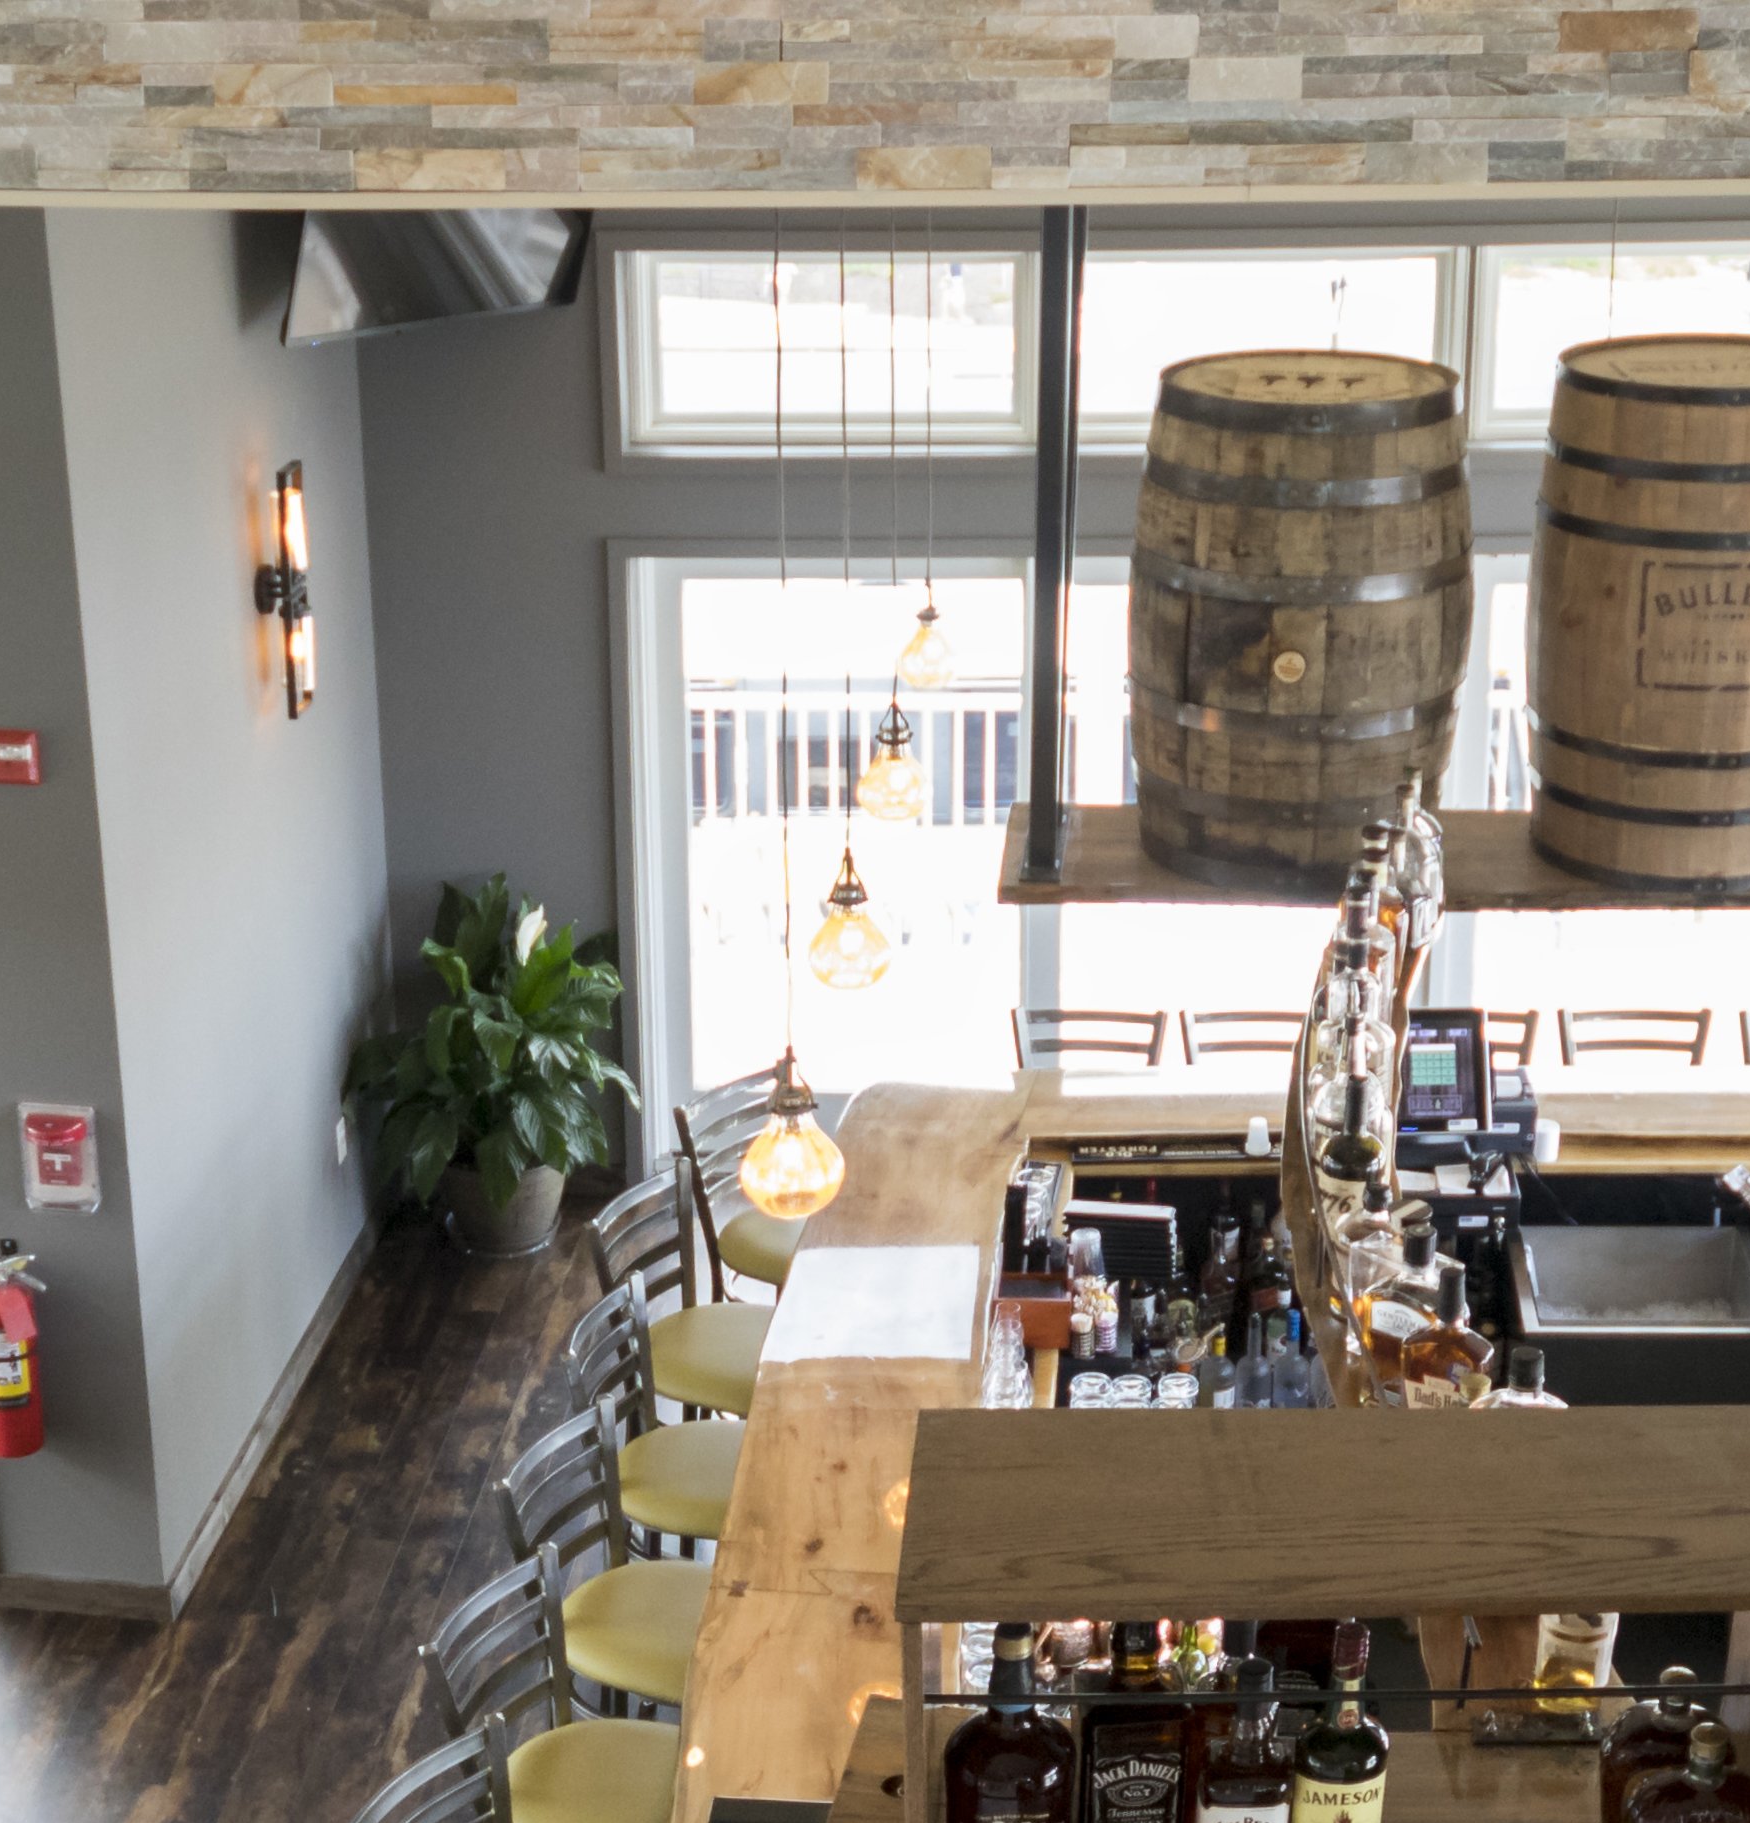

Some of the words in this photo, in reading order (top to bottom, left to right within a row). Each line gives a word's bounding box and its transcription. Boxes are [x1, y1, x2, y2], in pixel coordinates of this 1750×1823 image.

[1078, 1145, 1158, 1154] FORESTER
[1413, 1386, 1442, 1408] Dad's
[1093, 1765, 1128, 1790] JACK
[1129, 1760, 1182, 1785] DANIEL'S
[1302, 1786, 1381, 1806] JAMESON
